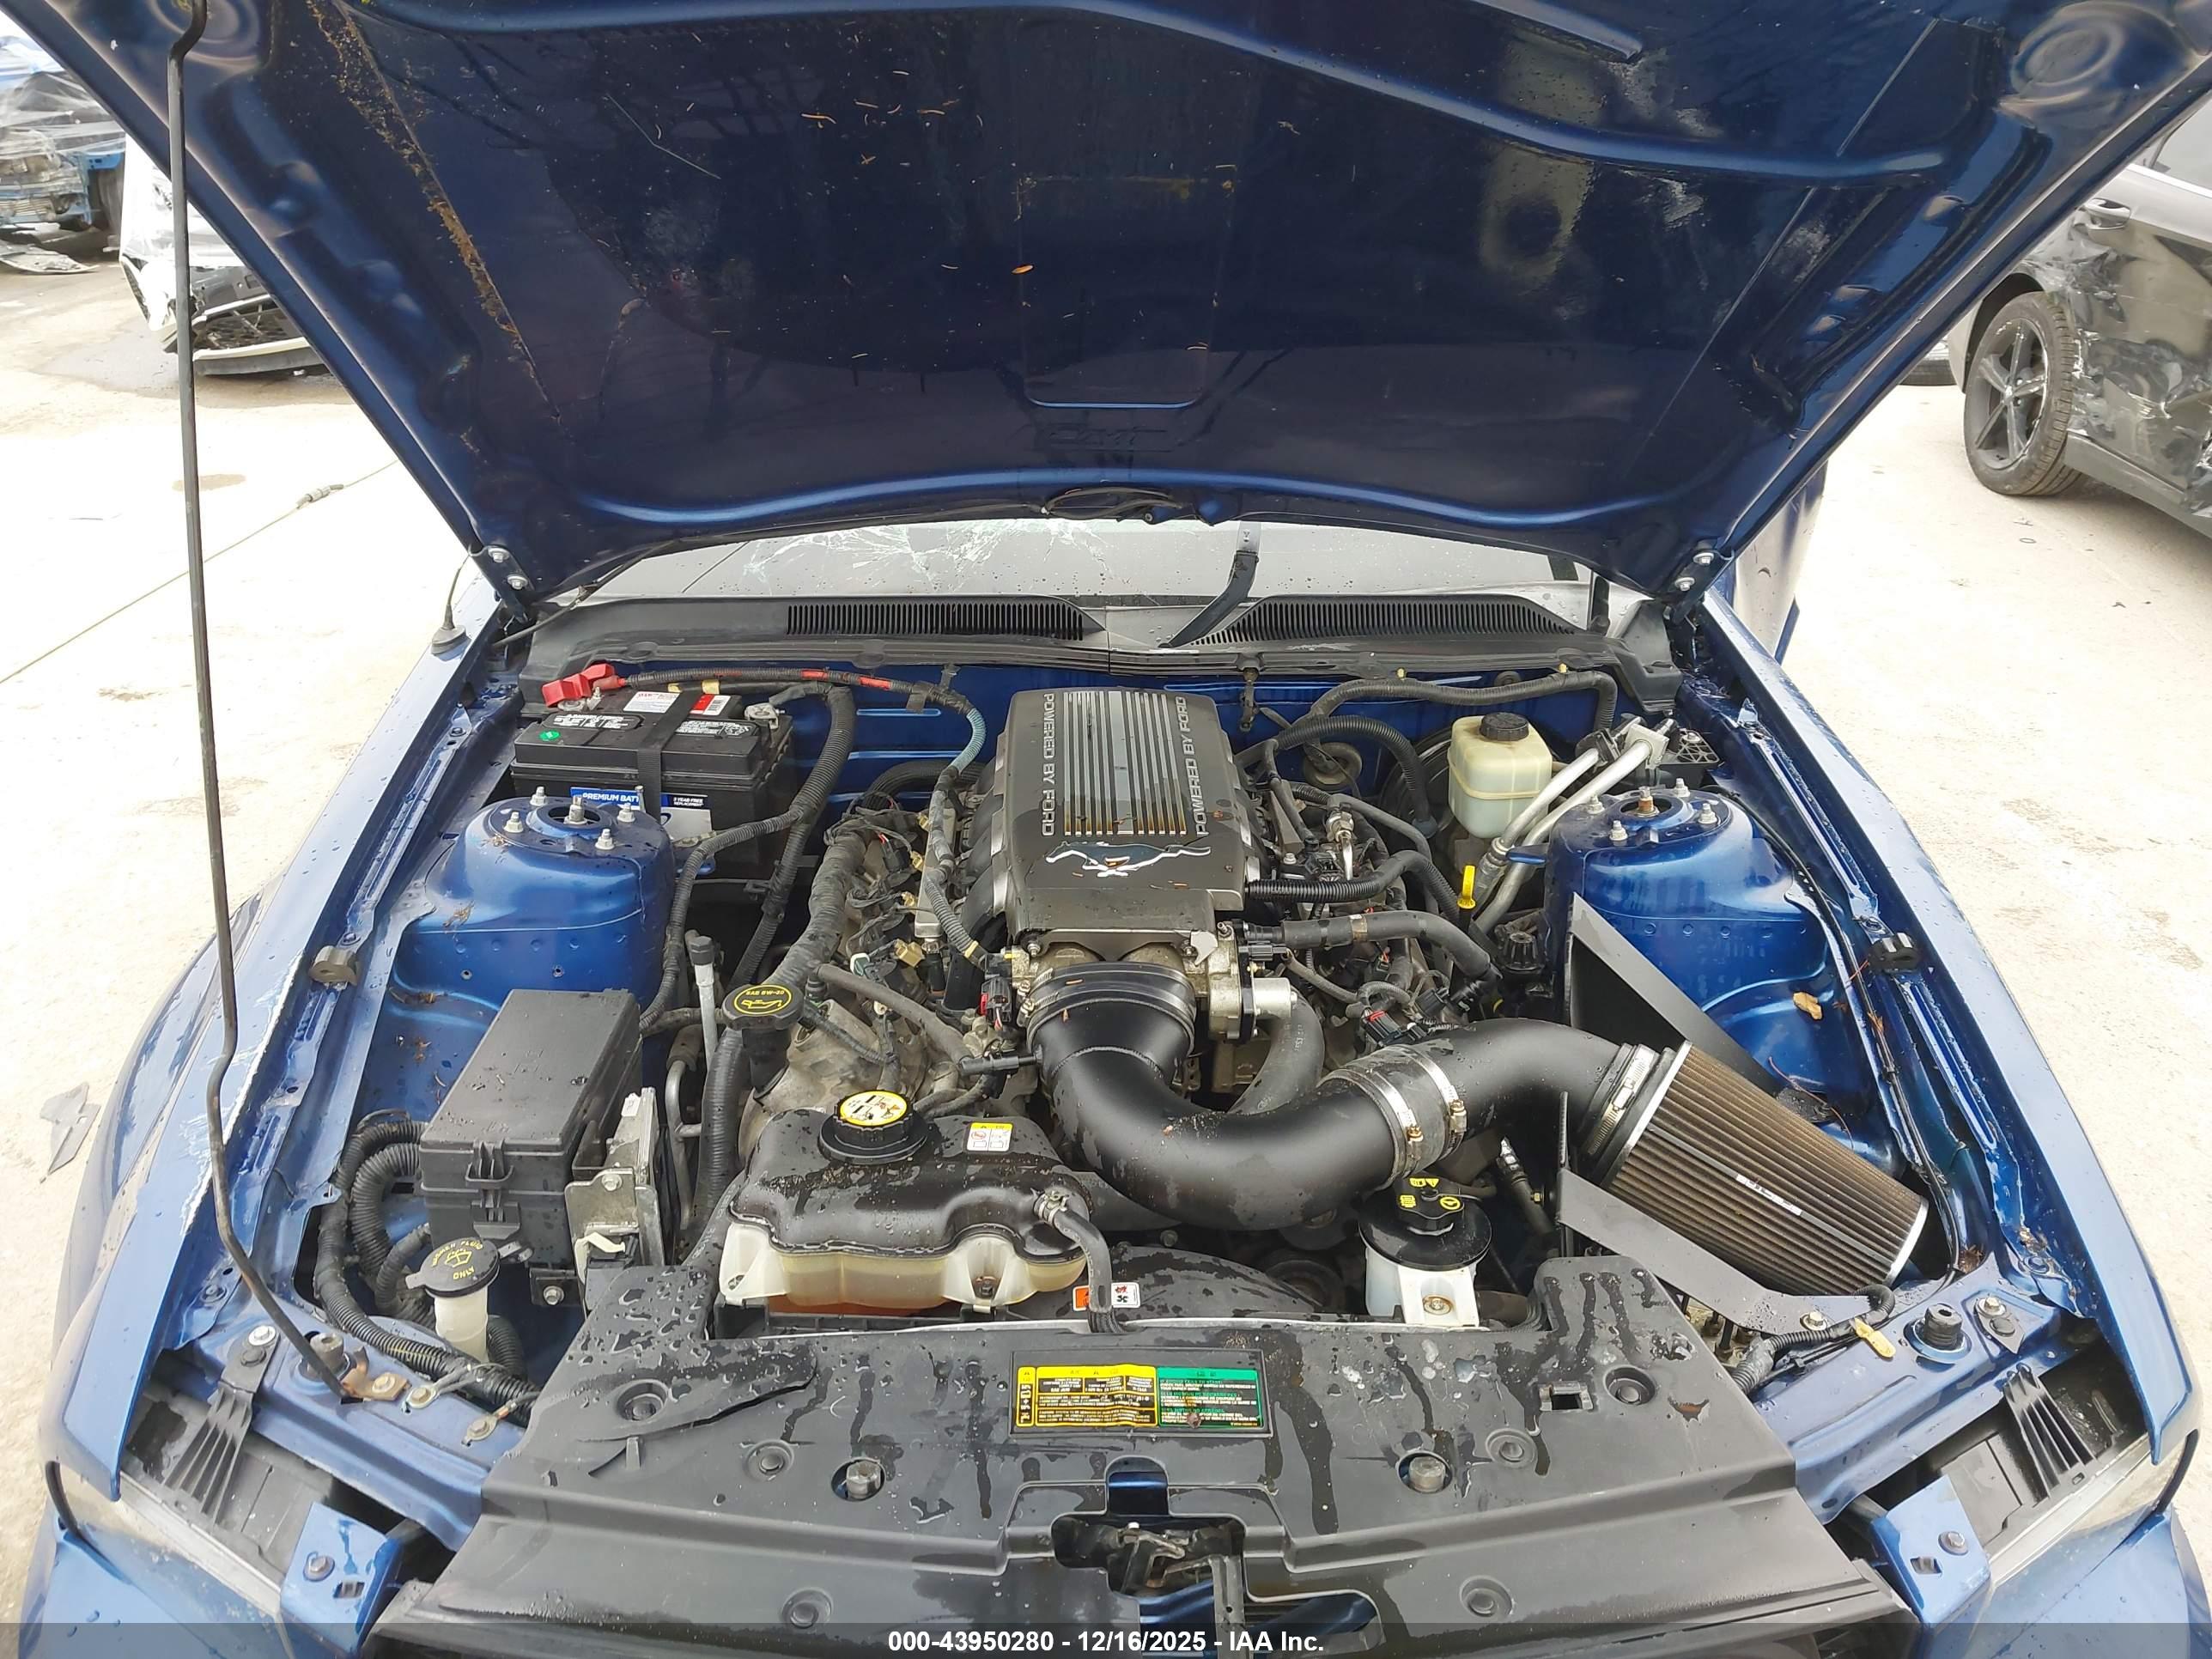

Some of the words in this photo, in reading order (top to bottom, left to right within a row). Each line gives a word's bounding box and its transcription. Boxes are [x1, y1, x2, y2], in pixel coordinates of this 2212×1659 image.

[1043, 693, 1055, 759] POWERED
[1176, 696, 1190, 732] FORD
[1182, 735, 1195, 755] BY
[1042, 763, 1055, 784] BY
[582, 792, 619, 801] PREMIUM
[1184, 758, 1209, 836] POWERED
[1042, 789, 1055, 836] FORD
[453, 1266, 475, 1280] ONLY
